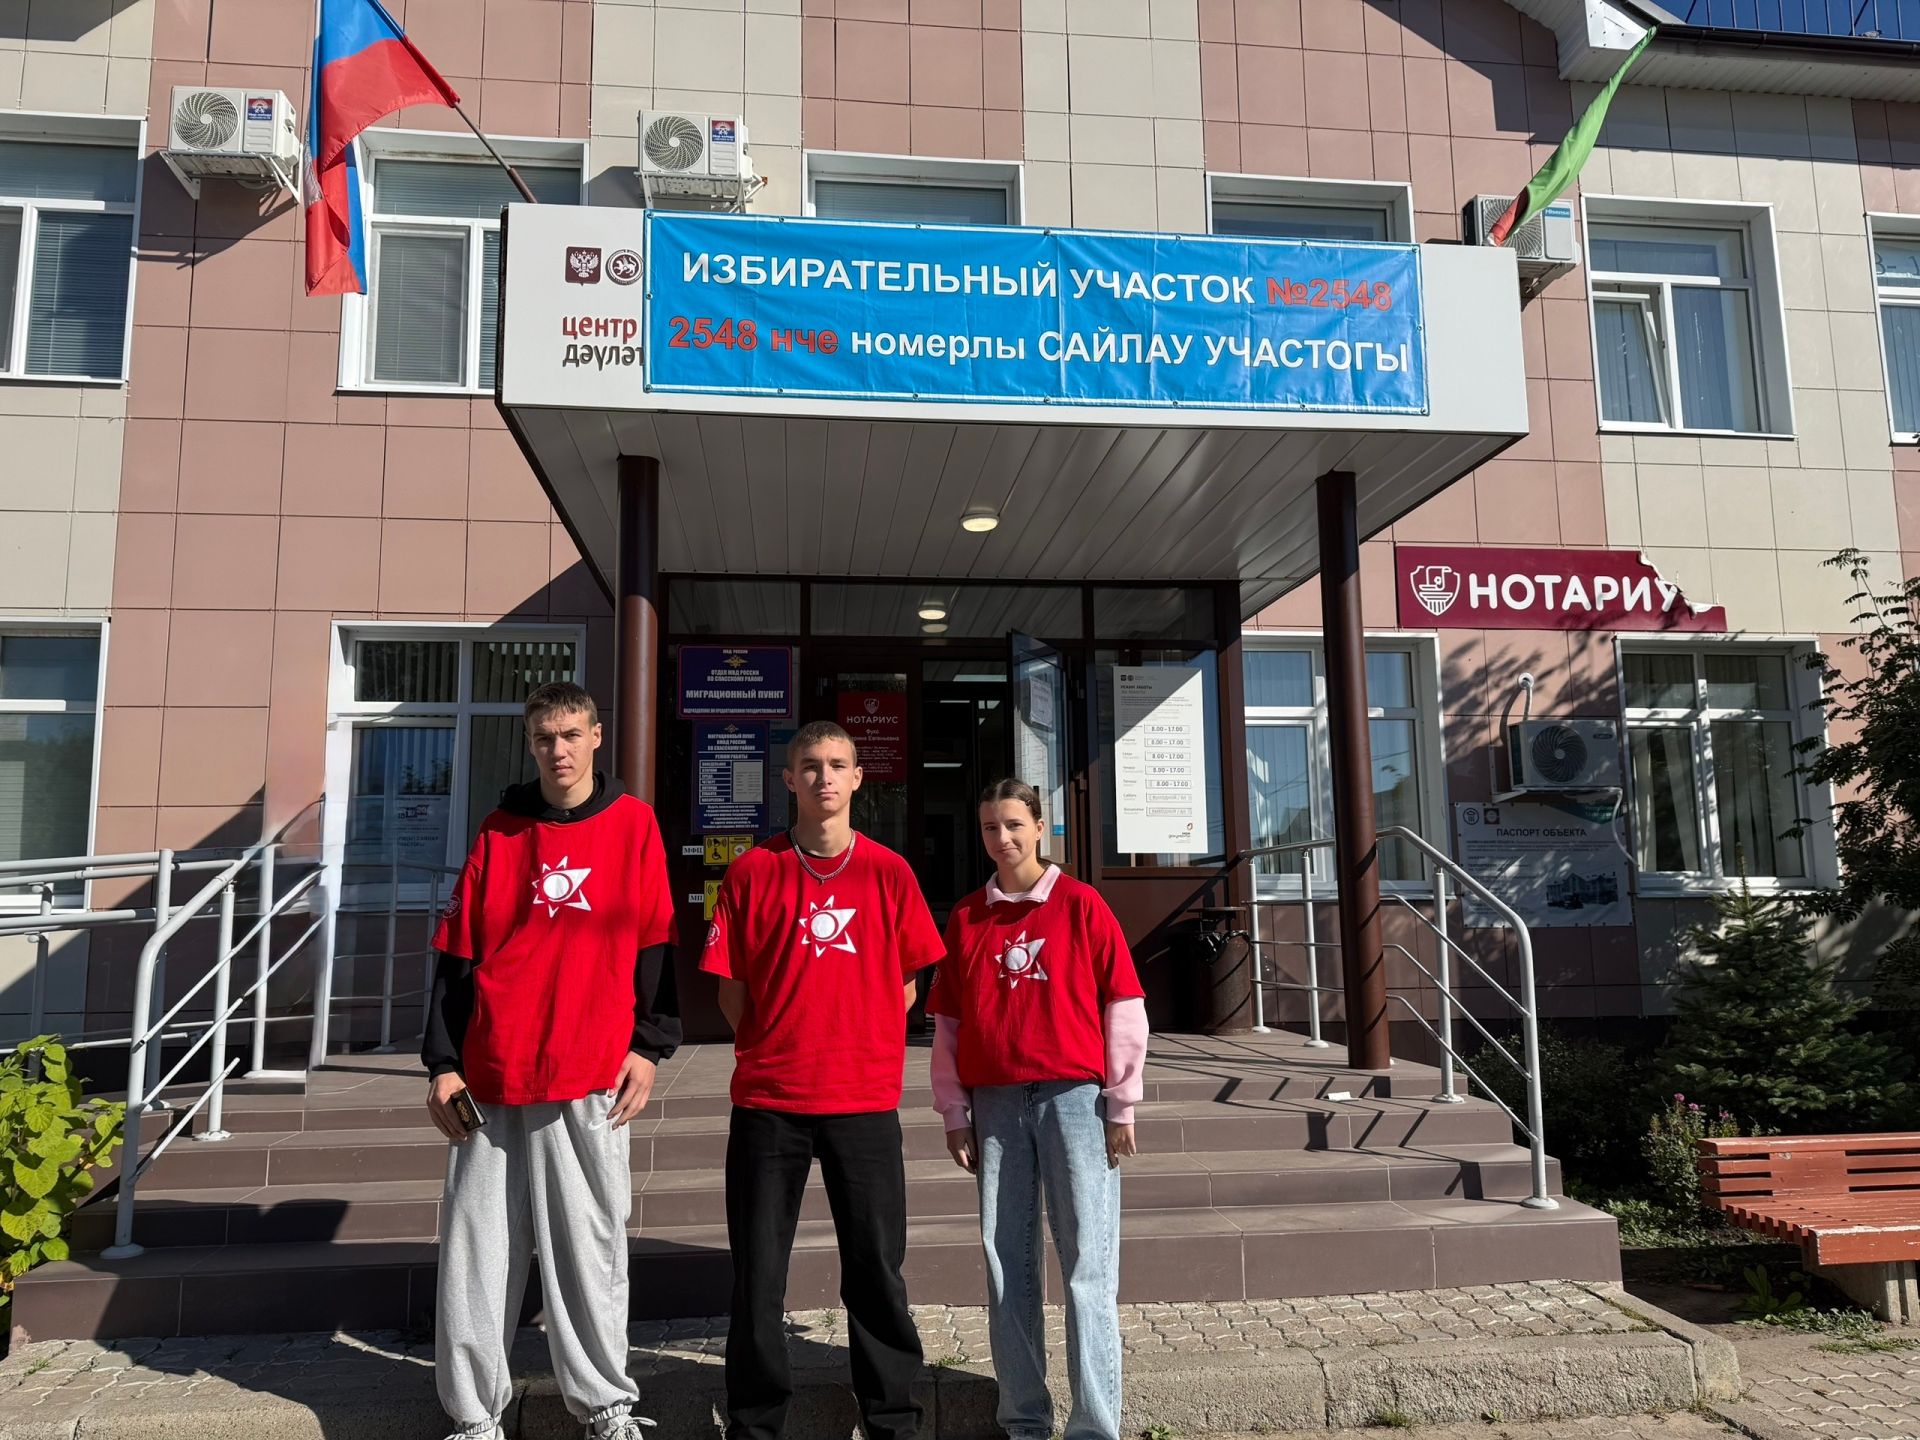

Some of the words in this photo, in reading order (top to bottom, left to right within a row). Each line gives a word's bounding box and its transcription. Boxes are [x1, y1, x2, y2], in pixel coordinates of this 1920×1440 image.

[683, 252, 1056, 298] ИЗБИРАТЕЛЬНЫЙ
[1070, 269, 1255, 304] УЧАСТОК
[1266, 277, 1392, 311] №2548
[562, 316, 637, 344] центр
[668, 316, 758, 350] 2548
[771, 328, 838, 354] нче
[852, 331, 1024, 366] номерлы
[1038, 327, 1193, 364] САЙЛАУ
[1204, 336, 1407, 372] УЧАСТОГЫ
[686, 690, 756, 699] МИГРАЦИОННЫЙ
[758, 690, 784, 698] ПУНКТ
[1496, 828, 1540, 837] ПАСПОРТ
[1543, 828, 1587, 837] ОБЪЕКТА
